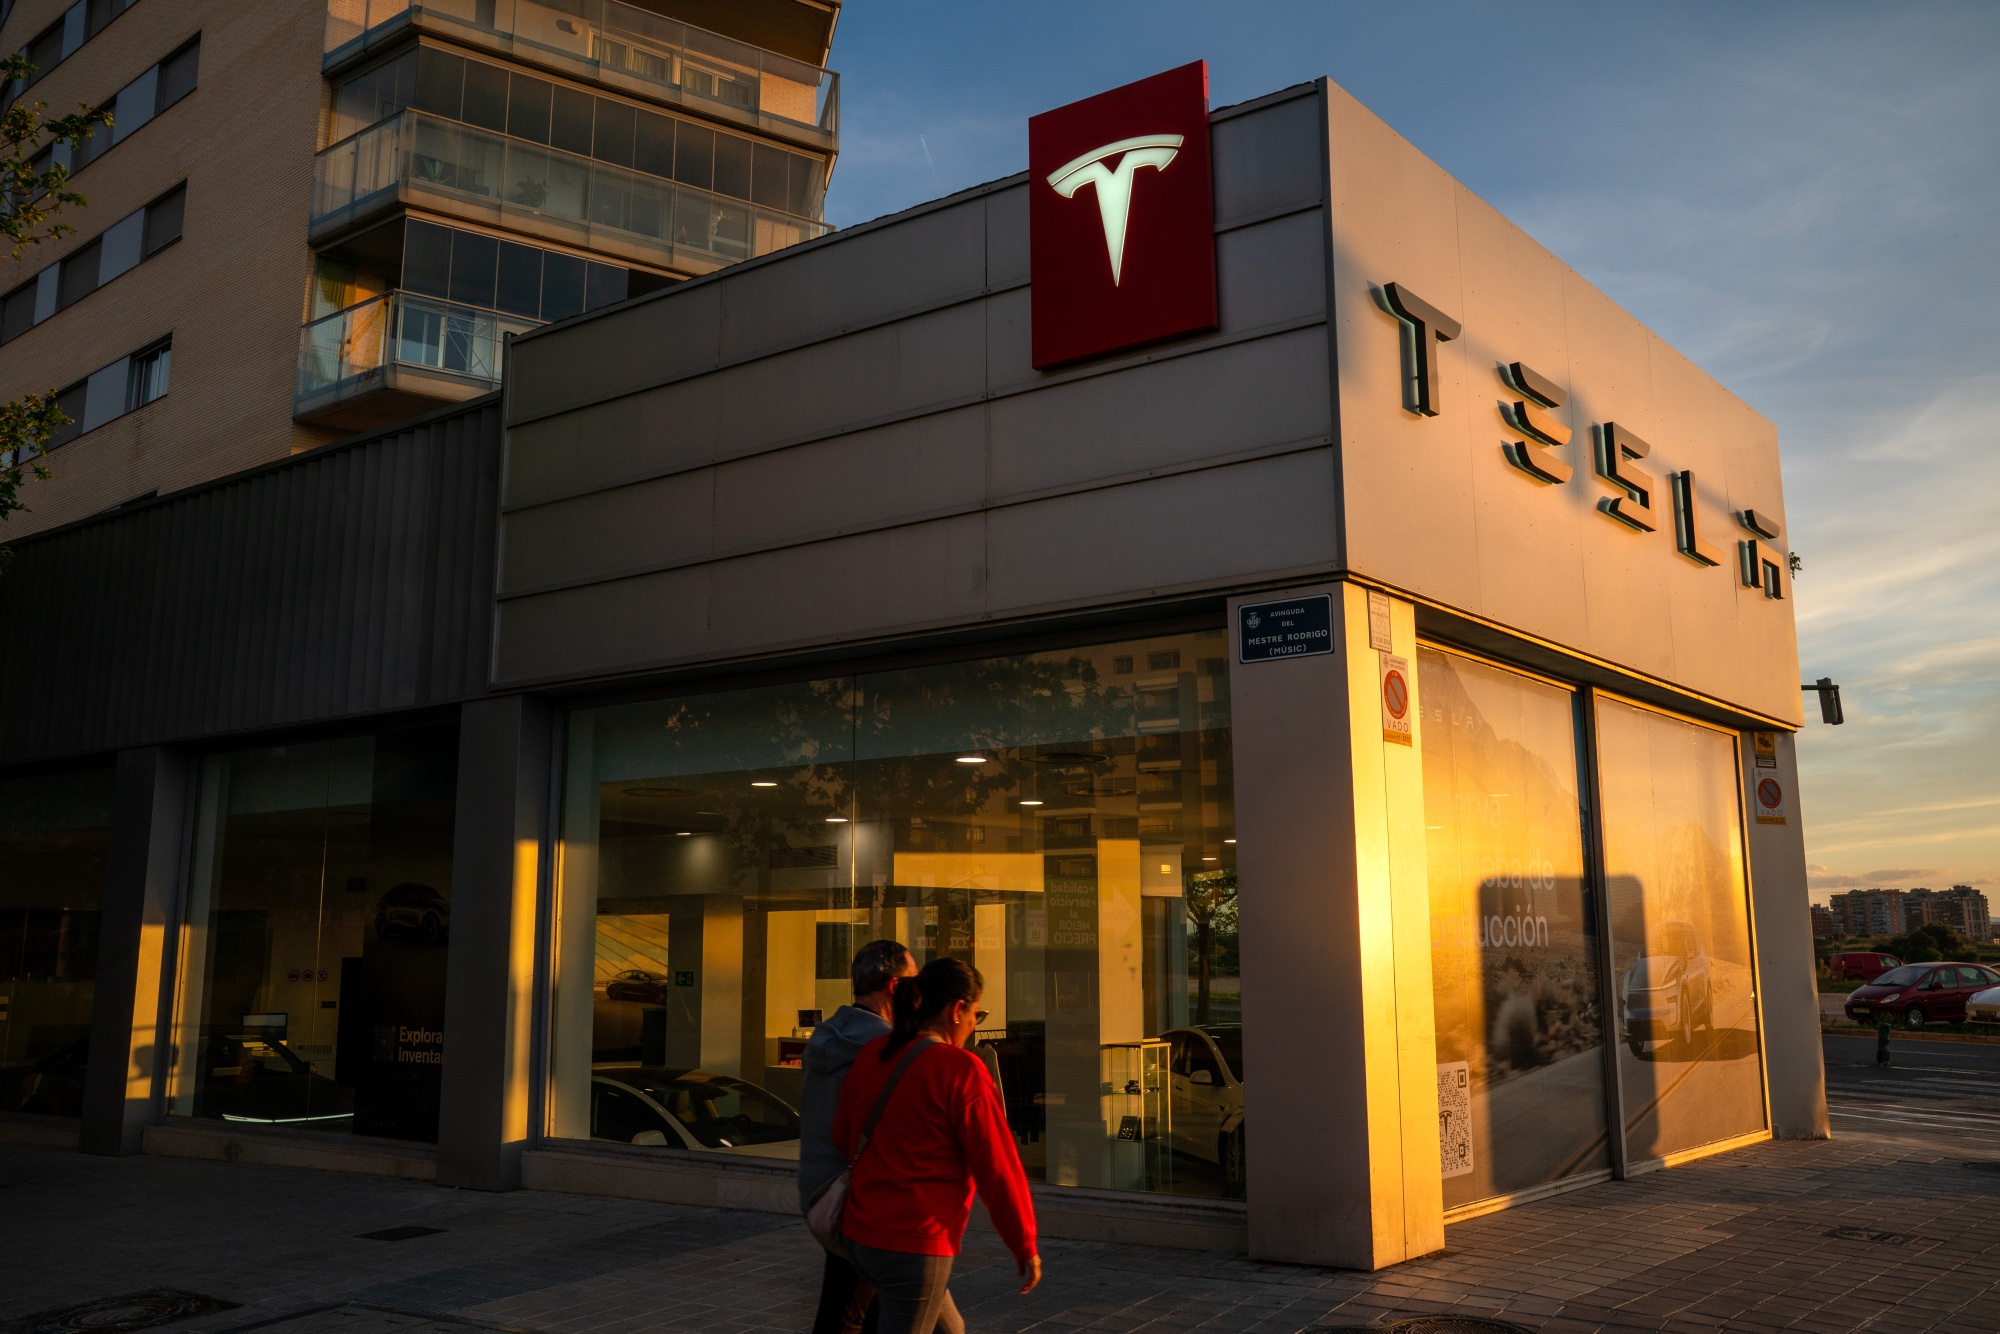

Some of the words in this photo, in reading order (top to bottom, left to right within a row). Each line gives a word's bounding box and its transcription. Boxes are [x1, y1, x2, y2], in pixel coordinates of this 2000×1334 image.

[1383, 281, 1785, 600] TESLA
[1270, 608, 1305, 617] AVINGUDA
[1248, 634, 1283, 646] MESTRE
[1287, 629, 1328, 641] RODRIGO
[1269, 643, 1307, 656] (MÚSIC)
[1386, 718, 1409, 733] VADO
[1760, 809, 1783, 817] VADO
[1529, 848, 1555, 891] de
[399, 1026, 442, 1046] Explora
